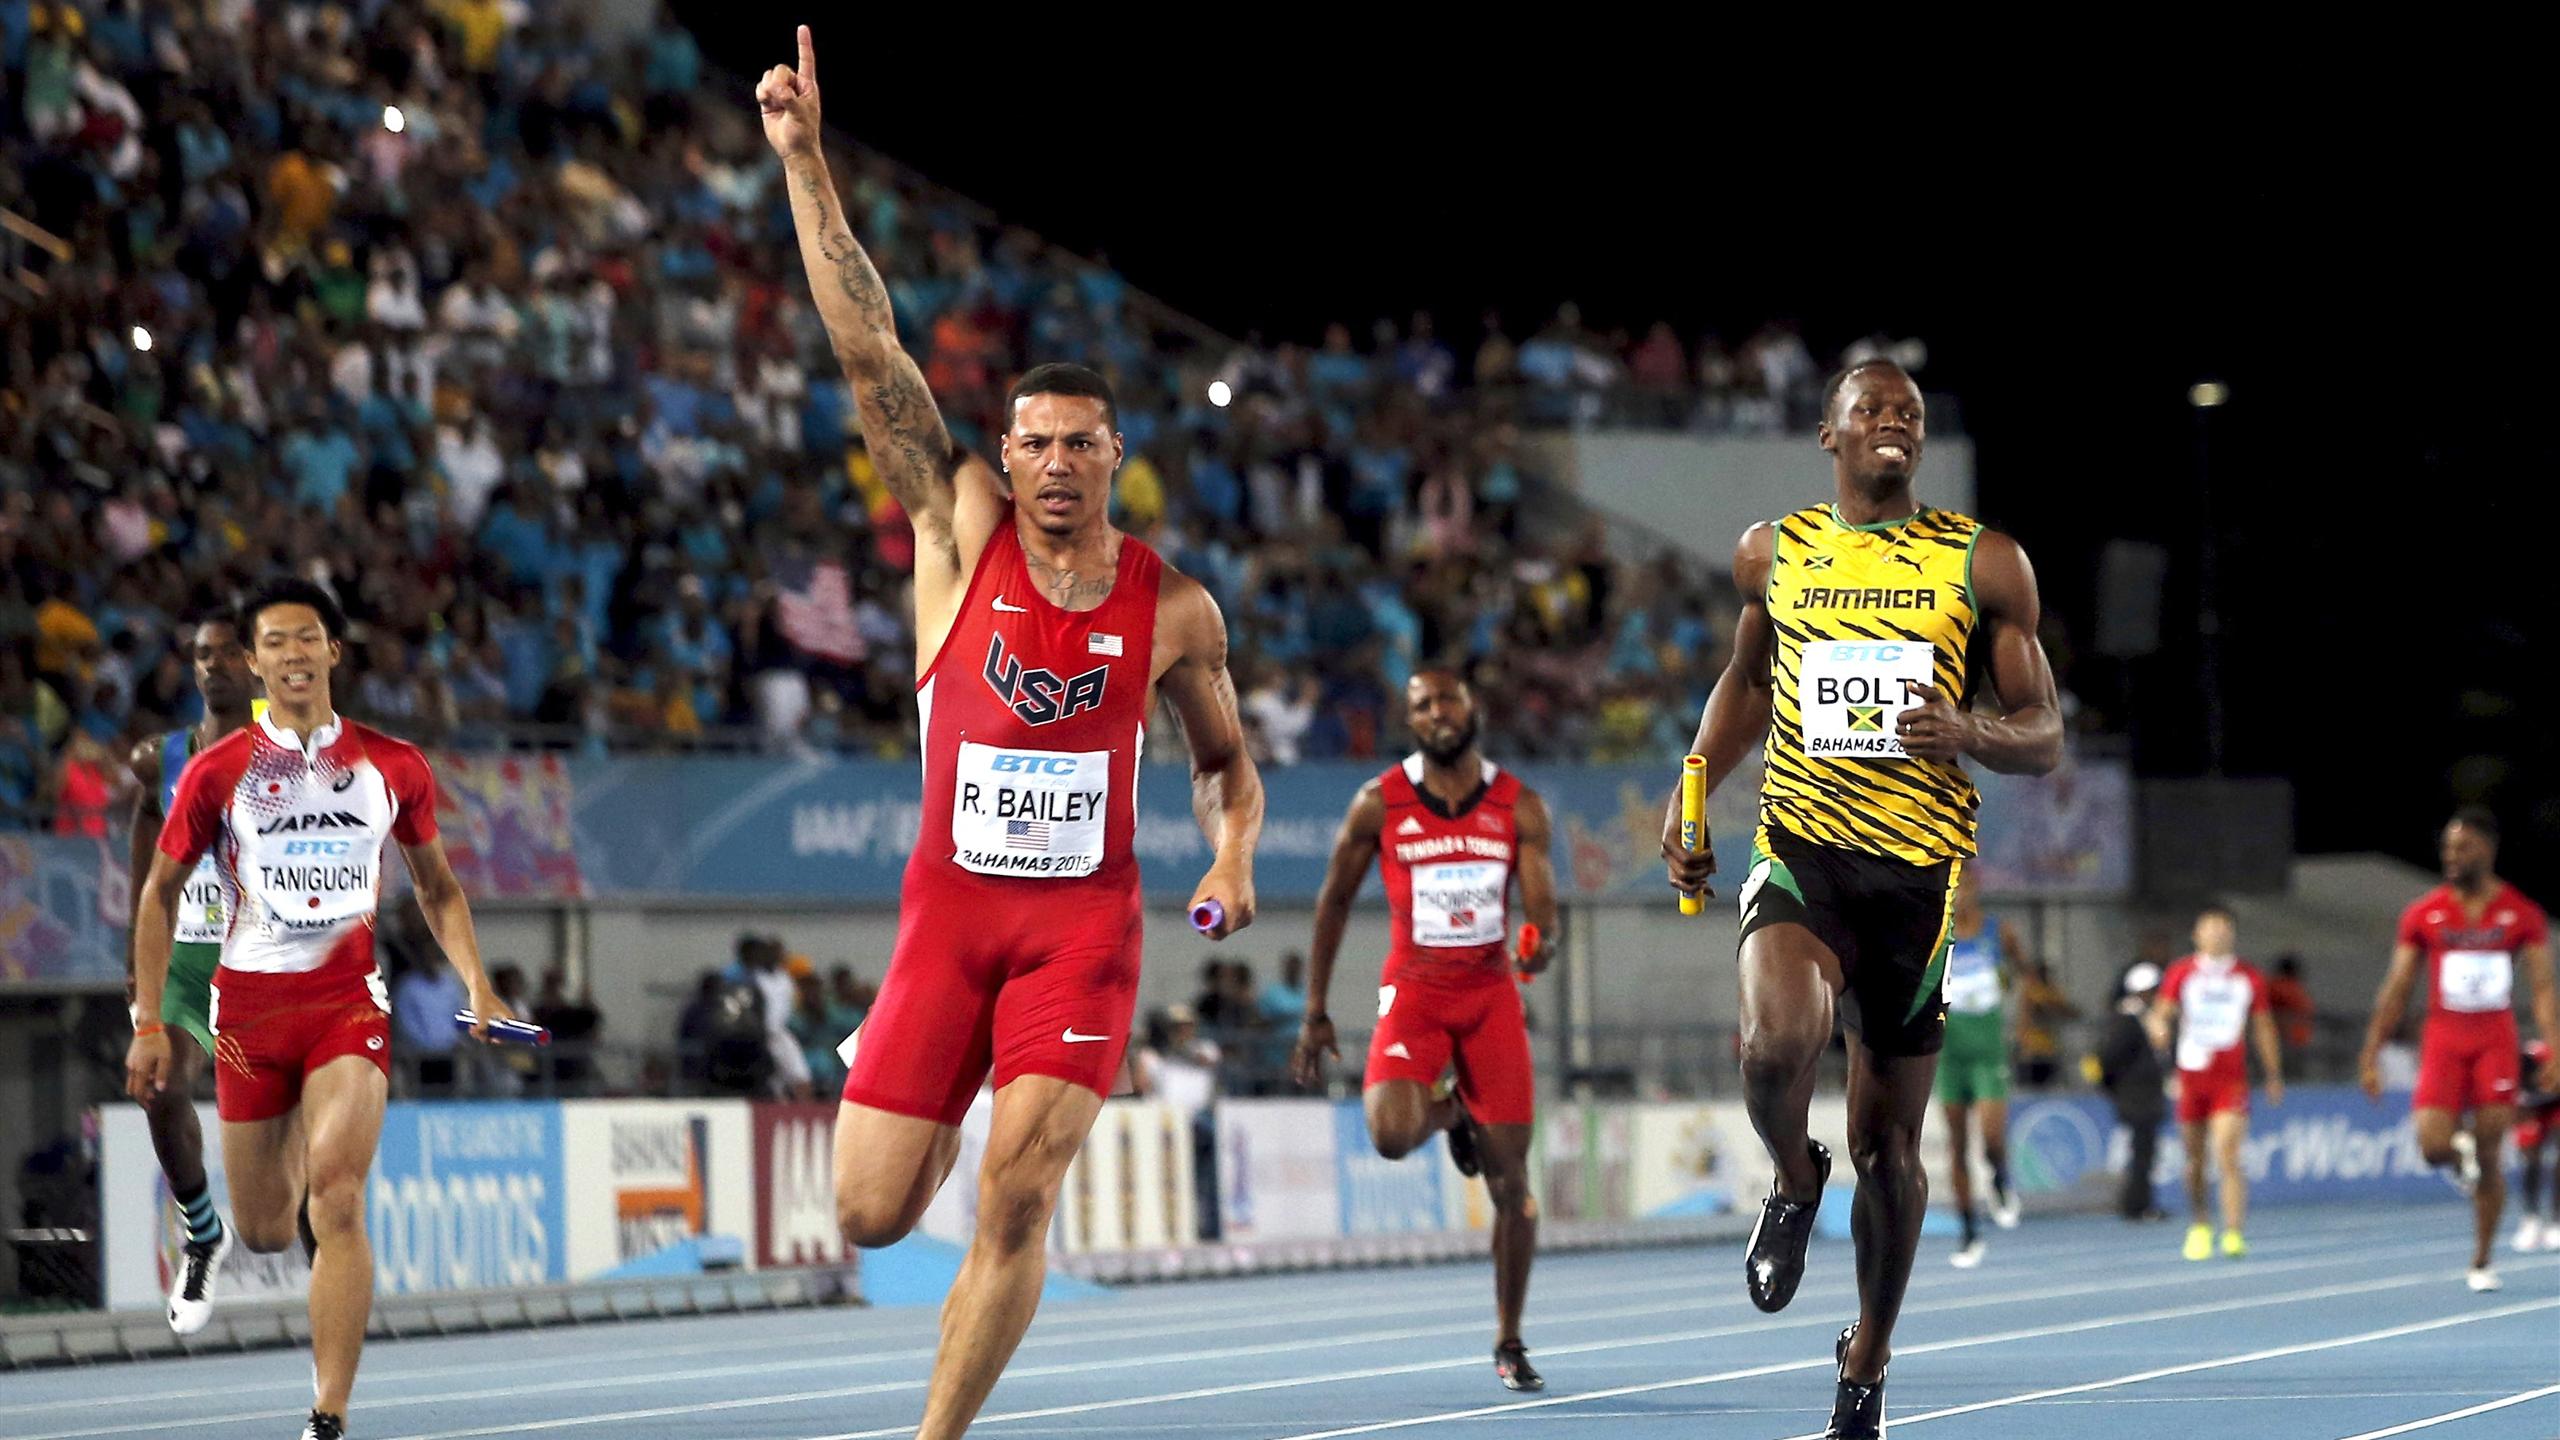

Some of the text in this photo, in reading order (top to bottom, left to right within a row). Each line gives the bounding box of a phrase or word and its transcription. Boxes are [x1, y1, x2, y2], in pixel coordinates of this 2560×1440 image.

[1793, 588, 1936, 610] JAMAICA
[1831, 645, 1904, 662] BTC
[983, 631, 1109, 727] USA
[1817, 677, 1918, 705] BOLT
[1812, 737, 1887, 752] BAHAMAS
[990, 754, 1078, 776] BTC
[962, 782, 1103, 822] R. BAILEY
[258, 811, 369, 837] JAPAN
[284, 840, 350, 856] BTC
[1055, 855, 1092, 872] 2015
[260, 864, 369, 892] TANIGUCHI
[183, 883, 222, 905] VID
